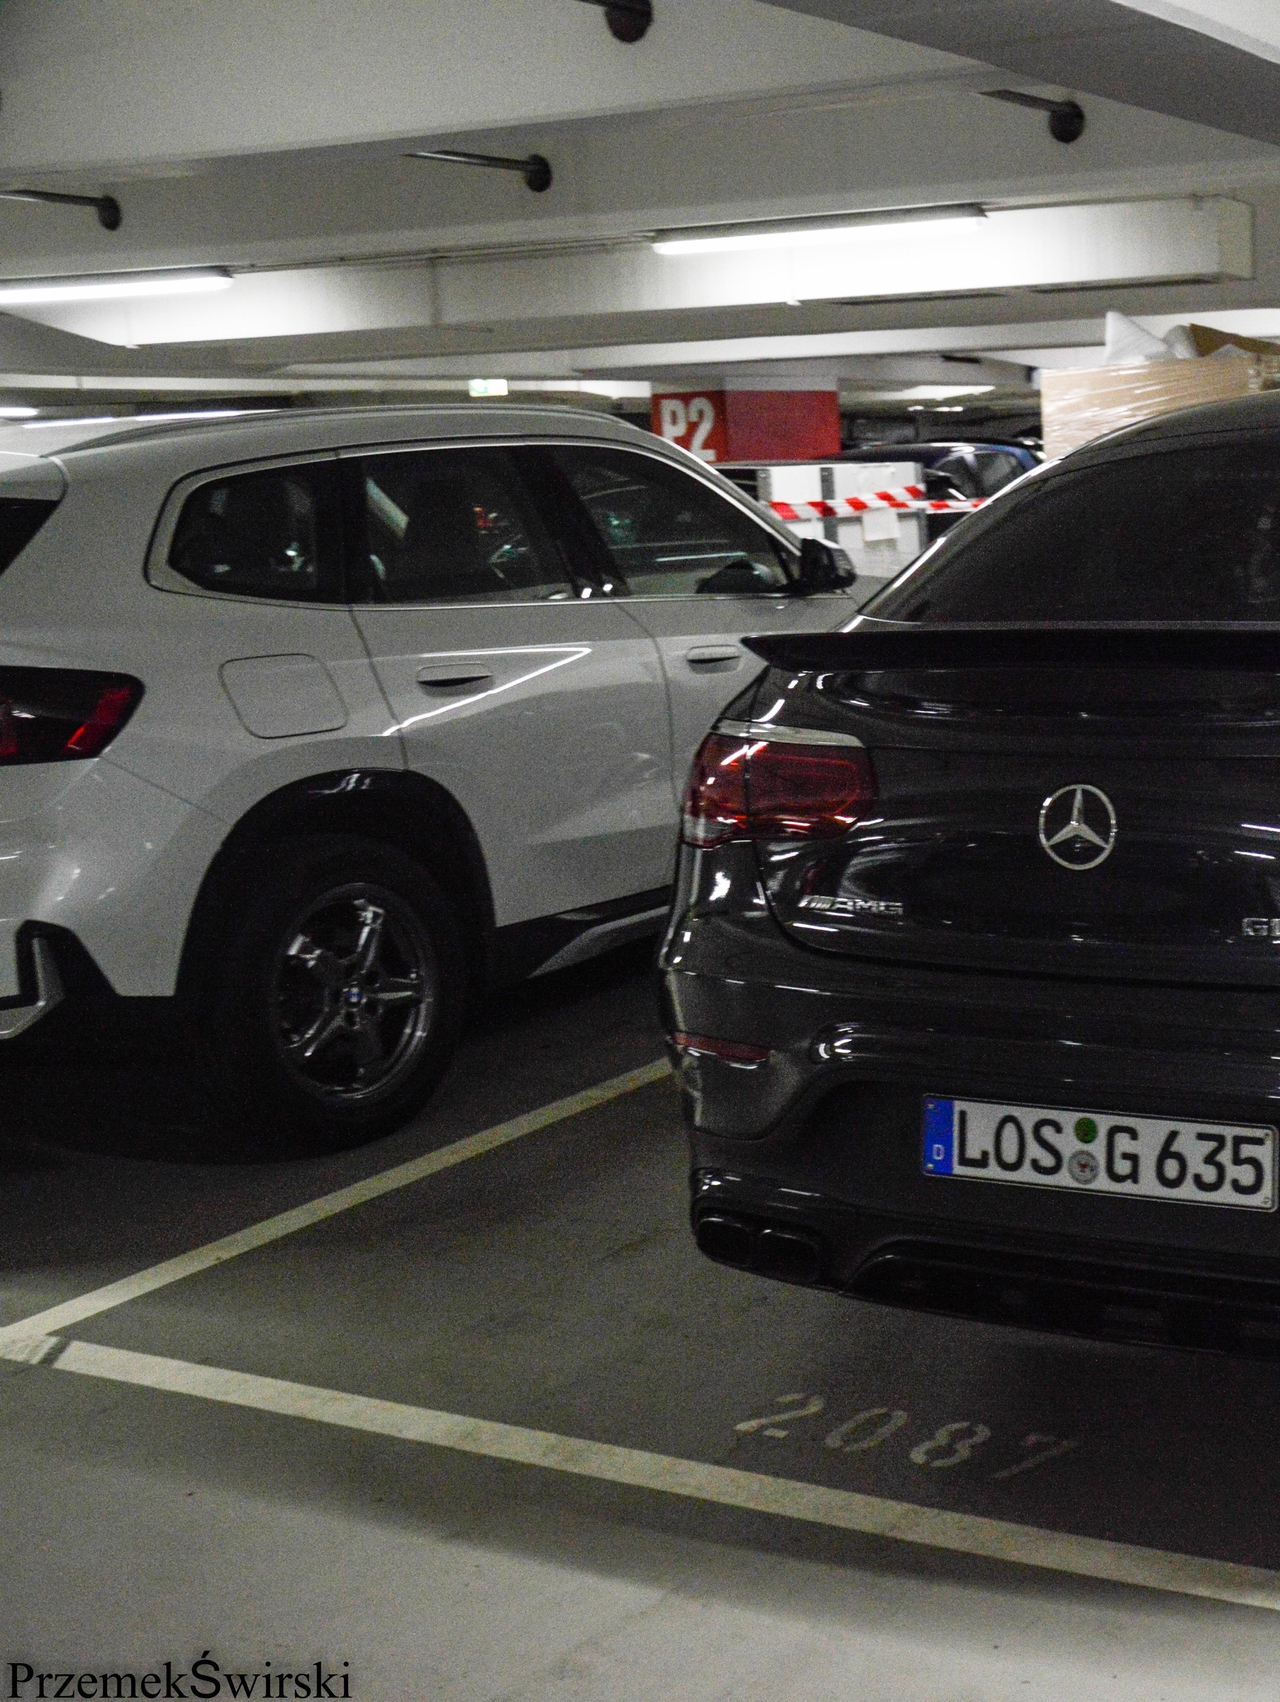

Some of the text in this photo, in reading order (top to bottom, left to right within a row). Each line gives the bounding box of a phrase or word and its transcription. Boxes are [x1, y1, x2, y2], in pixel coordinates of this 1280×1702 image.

[660, 397, 717, 462] P2
[831, 897, 904, 915] AMG
[957, 1109, 1064, 1176] LOS
[1105, 1124, 1140, 1185] G
[1155, 1130, 1266, 1196] 635
[734, 1393, 1078, 1481] 2087
